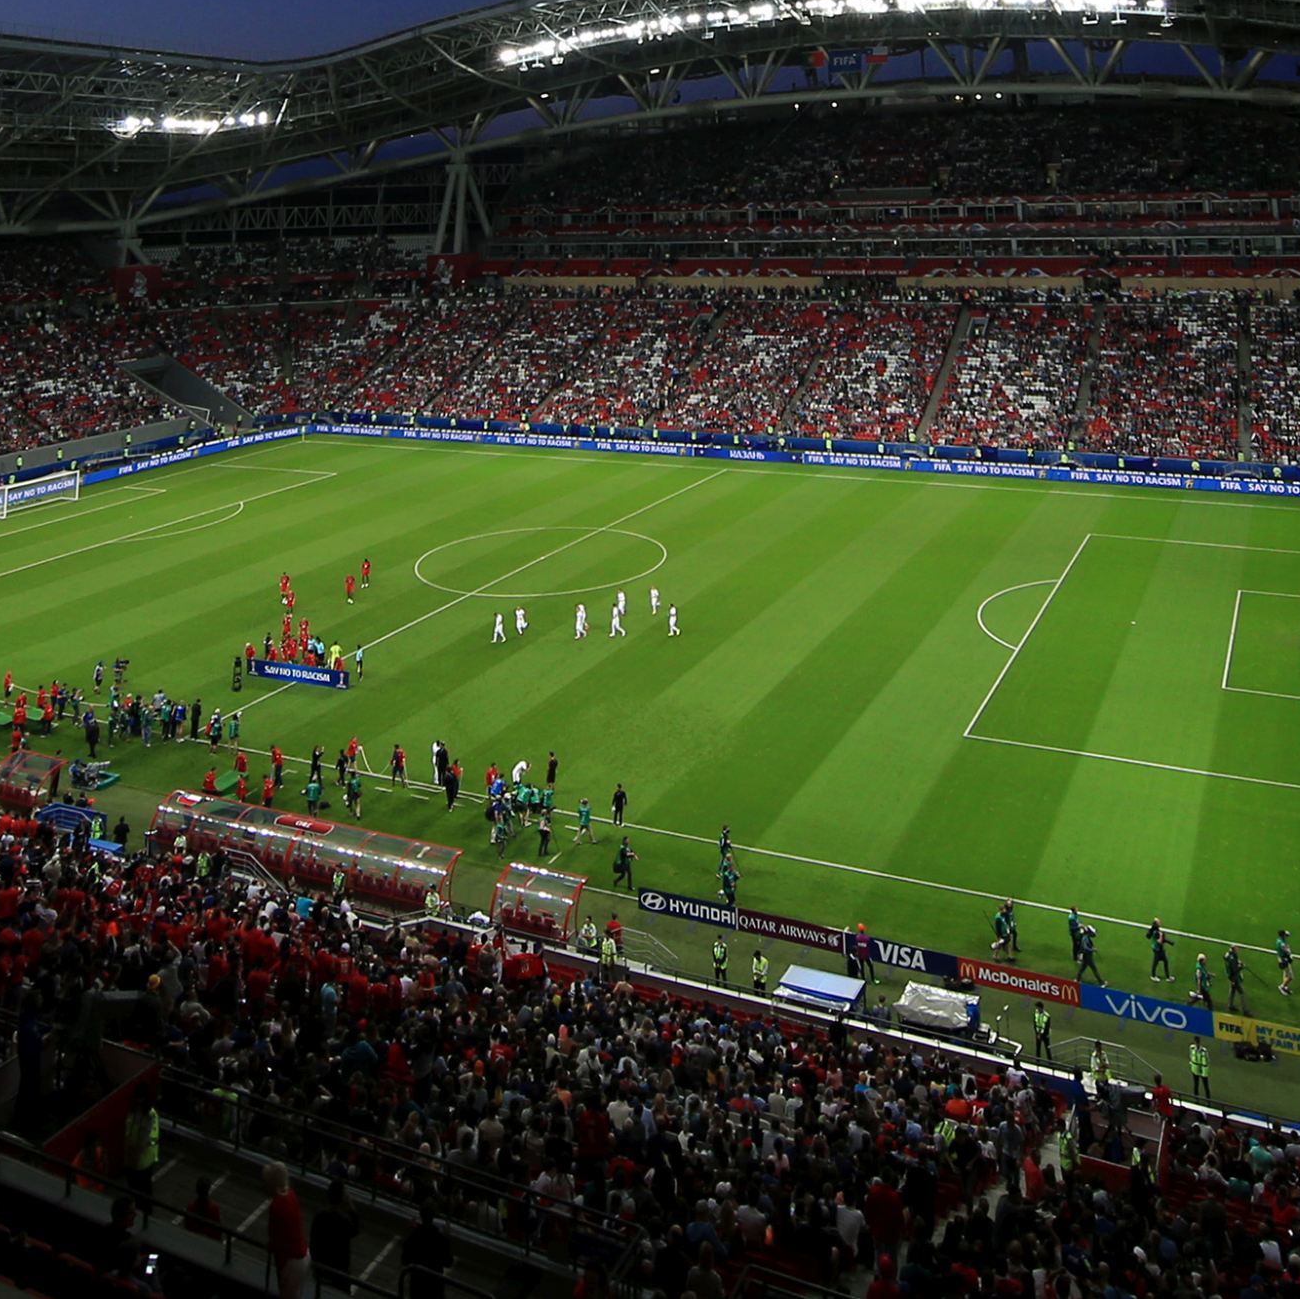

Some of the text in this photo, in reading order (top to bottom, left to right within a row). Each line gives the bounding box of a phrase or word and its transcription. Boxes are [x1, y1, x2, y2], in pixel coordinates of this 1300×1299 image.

[833, 57, 856, 66] FIFA
[597, 442, 611, 450] FIFA
[616, 443, 627, 451] SAY
[651, 445, 677, 454] RACISM
[119, 450, 191, 474] FIFA SAY NO TO RACISM
[808, 455, 900, 468] FIFA SAY NO TO RACISM
[934, 463, 1034, 476] FIFA SAY NO TO RACISM
[1070, 472, 1181, 486] FIFA SAY NO TO RACISM
[9, 491, 22, 501] SAY
[24, 488, 35, 498] NO
[37, 486, 45, 495] TO
[47, 479, 74, 492] RACISM
[1221, 481, 1241, 490] FIFA
[1249, 483, 1266, 492] SAY
[1270, 484, 1284, 493] NO
[1287, 485, 1300, 494] TO
[265, 665, 279, 674] SAY
[280, 668, 291, 676] NO
[292, 669, 301, 678] TO
[302, 671, 330, 682] RACISM
[669, 899, 735, 925] HYUNDAI
[739, 915, 826, 945] QATAR AIRWAYS
[874, 939, 926, 971] VISA
[978, 967, 1059, 996] McDonald's
[1105, 993, 1187, 1030] vivo
[1218, 1021, 1243, 1036] FIFA
[1256, 1025, 1273, 1036] MY
[1269, 1037, 1293, 1051] FAIR
